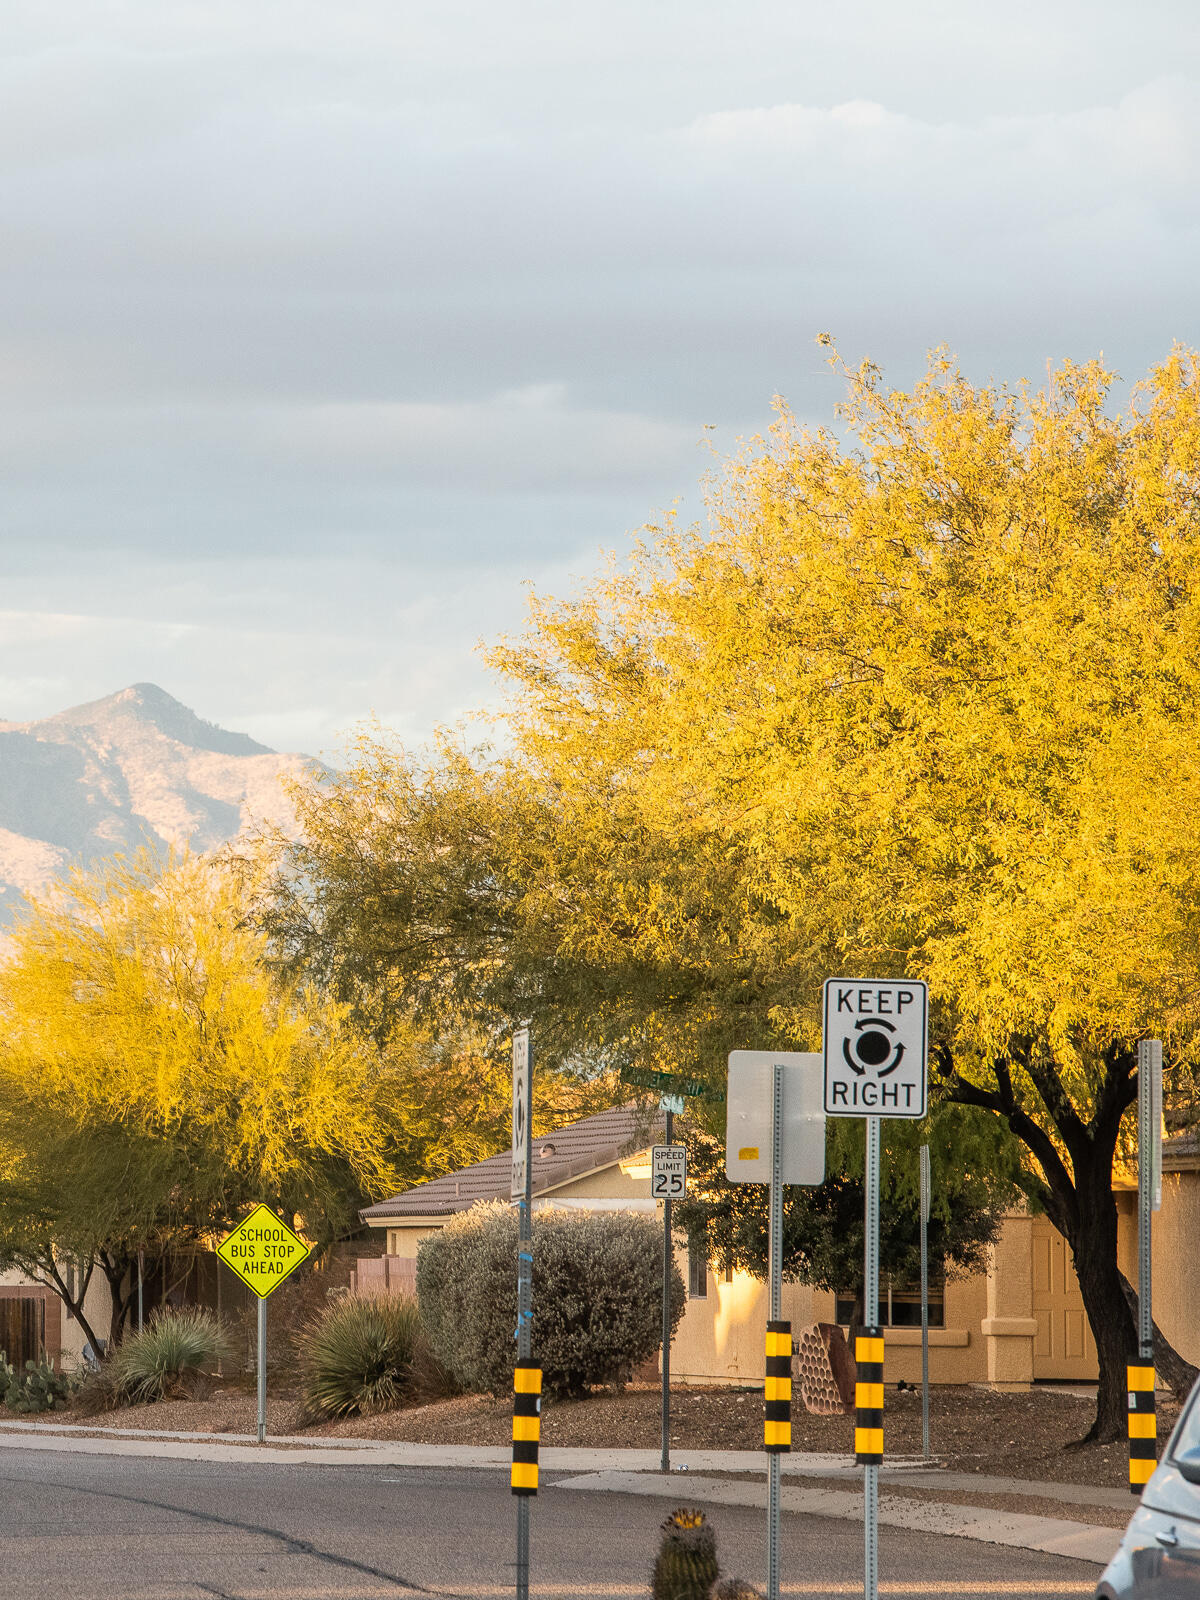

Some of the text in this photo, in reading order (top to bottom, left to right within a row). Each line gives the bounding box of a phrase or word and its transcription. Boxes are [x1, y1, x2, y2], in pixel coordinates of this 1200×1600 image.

[837, 988, 914, 1014] KEEP
[832, 1080, 916, 1107] RIGHT
[655, 1151, 684, 1160] SPEED
[657, 1162, 681, 1171] LIMIT
[655, 1174, 682, 1193] 25
[240, 1229, 287, 1241] SCHOOL
[231, 1245, 294, 1258] BUS STOP
[243, 1261, 283, 1274] AHEAD
